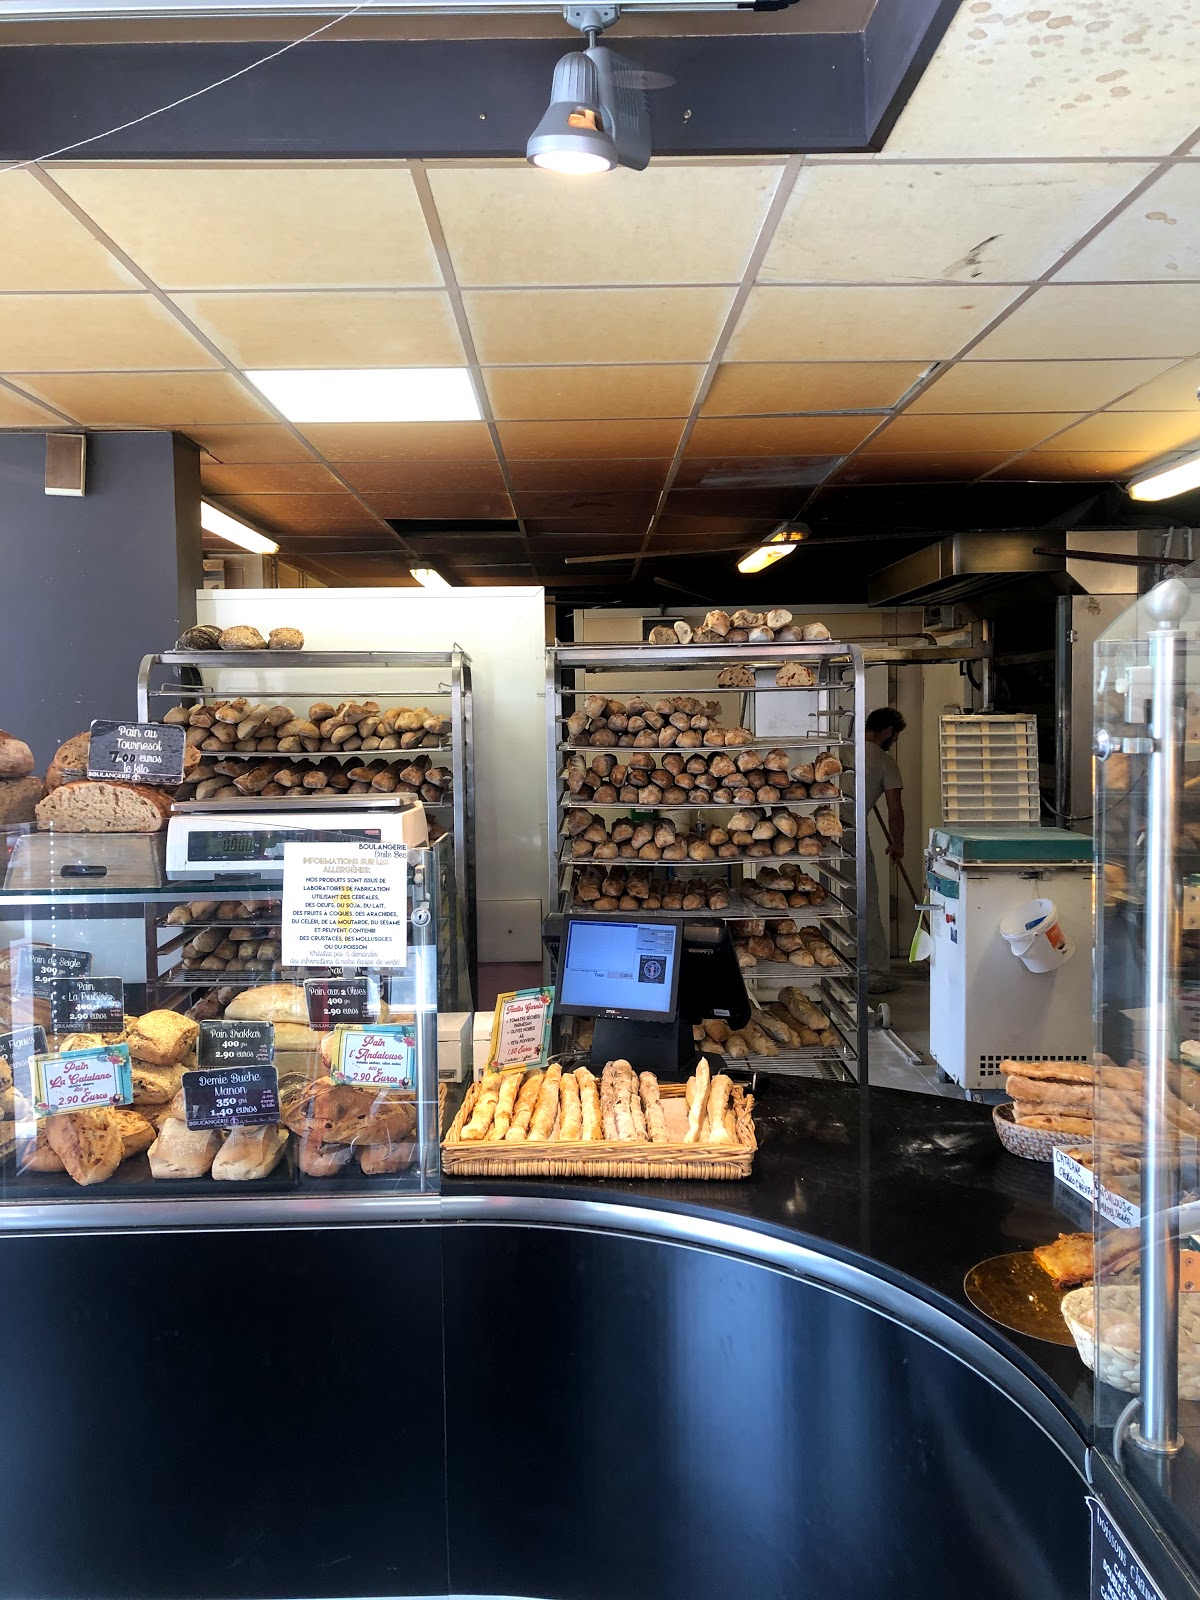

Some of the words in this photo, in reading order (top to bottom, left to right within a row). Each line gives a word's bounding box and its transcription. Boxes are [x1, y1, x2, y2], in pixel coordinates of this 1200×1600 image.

[118, 725, 141, 738] Pain
[144, 729, 158, 739] au
[116, 738, 162, 751] Tournesol
[139, 754, 162, 763] euros
[123, 762, 132, 773] le
[134, 763, 149, 774] kilo
[88, 771, 131, 779] BOULANGERIE
[358, 843, 407, 851] BOULANGERIE
[303, 857, 358, 865] INFORMATIONS
[376, 858, 389, 866] LES
[29, 954, 46, 964] Pain
[48, 955, 57, 965] de
[59, 957, 81, 969] Seigle
[40, 966, 58, 974] 300
[77, 982, 95, 991] Pain
[309, 986, 326, 996] Pain
[327, 988, 340, 996] aux
[346, 986, 366, 996] Olives
[68, 992, 78, 1001] La
[75, 1003, 92, 1011] 400
[327, 998, 343, 1006] 400
[210, 1029, 228, 1038] Pain
[229, 1028, 261, 1038] Drakkar
[8, 1037, 35, 1050] Figues
[221, 1040, 239, 1049] 400
[361, 1035, 385, 1047] Pain
[215, 1051, 234, 1059] 2.90
[63, 1061, 89, 1074] Pain
[50, 1076, 65, 1089] La
[69, 1072, 112, 1085] Catalane
[199, 1074, 228, 1086] Demie
[230, 1071, 261, 1083] Buche
[353, 1072, 371, 1081] 2.90
[373, 1070, 398, 1083] Euros
[214, 1086, 247, 1096] Manon
[58, 1095, 78, 1105] 2.90
[81, 1091, 107, 1103] Euros
[216, 1097, 236, 1107] 350
[210, 1107, 233, 1117] 1.40
[235, 1105, 257, 1114] euros
